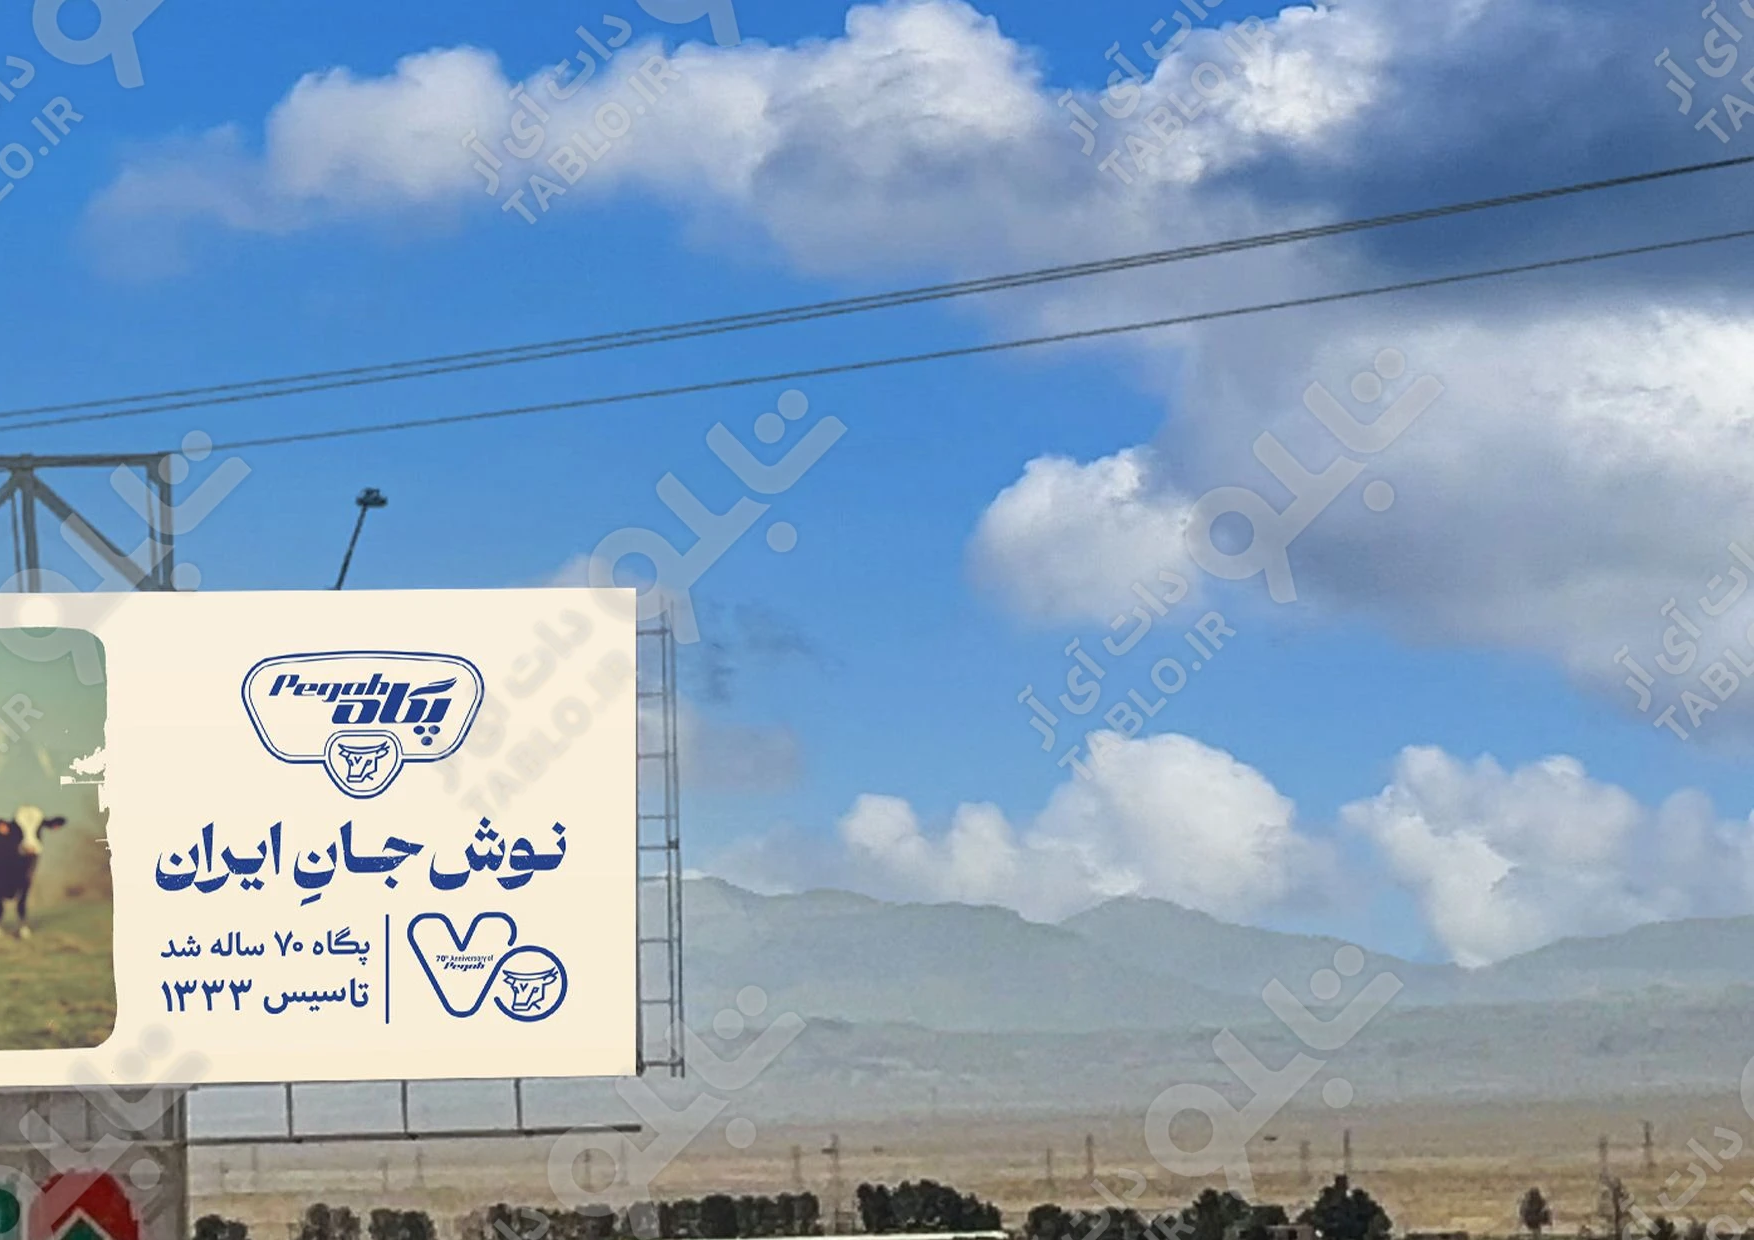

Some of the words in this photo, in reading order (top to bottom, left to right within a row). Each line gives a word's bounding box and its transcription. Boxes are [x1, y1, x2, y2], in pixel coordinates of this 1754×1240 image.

[268, 673, 391, 703] Pegah
[332, 677, 458, 747] پگاه
[155, 821, 282, 894] ایران
[429, 816, 567, 892] نوش
[160, 935, 202, 958] شد
[210, 931, 265, 957] ساله
[273, 930, 304, 957] ۷۰
[312, 927, 371, 966] پگاه
[161, 979, 253, 1012] ۱۳۳۳
[263, 977, 369, 1015] تاسیس
